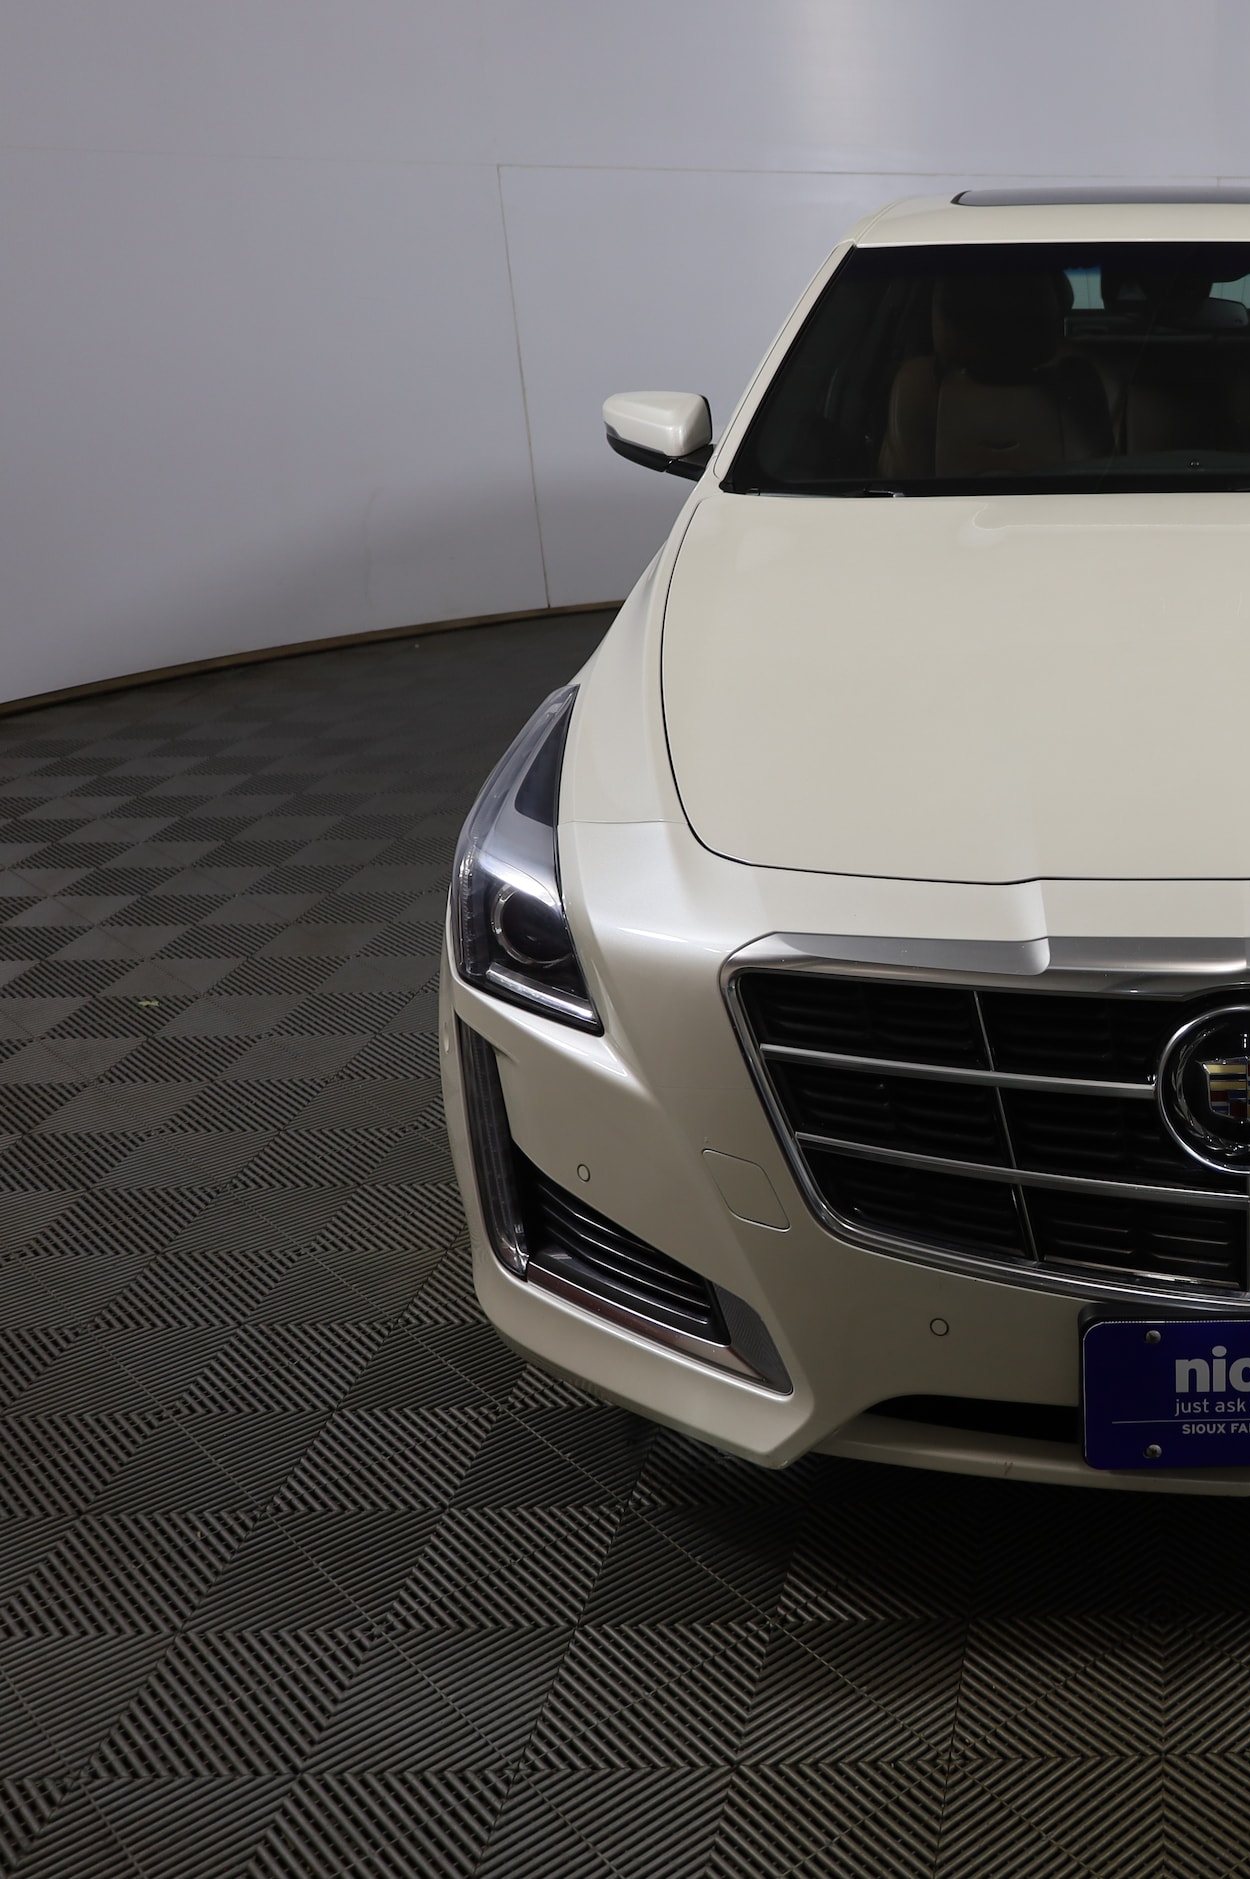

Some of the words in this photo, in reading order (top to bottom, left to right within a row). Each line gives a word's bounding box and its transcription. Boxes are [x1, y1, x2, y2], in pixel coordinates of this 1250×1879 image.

[1174, 1398, 1210, 1417] just
[1214, 1397, 1246, 1413] ask
[1182, 1423, 1226, 1435] SIOUX
